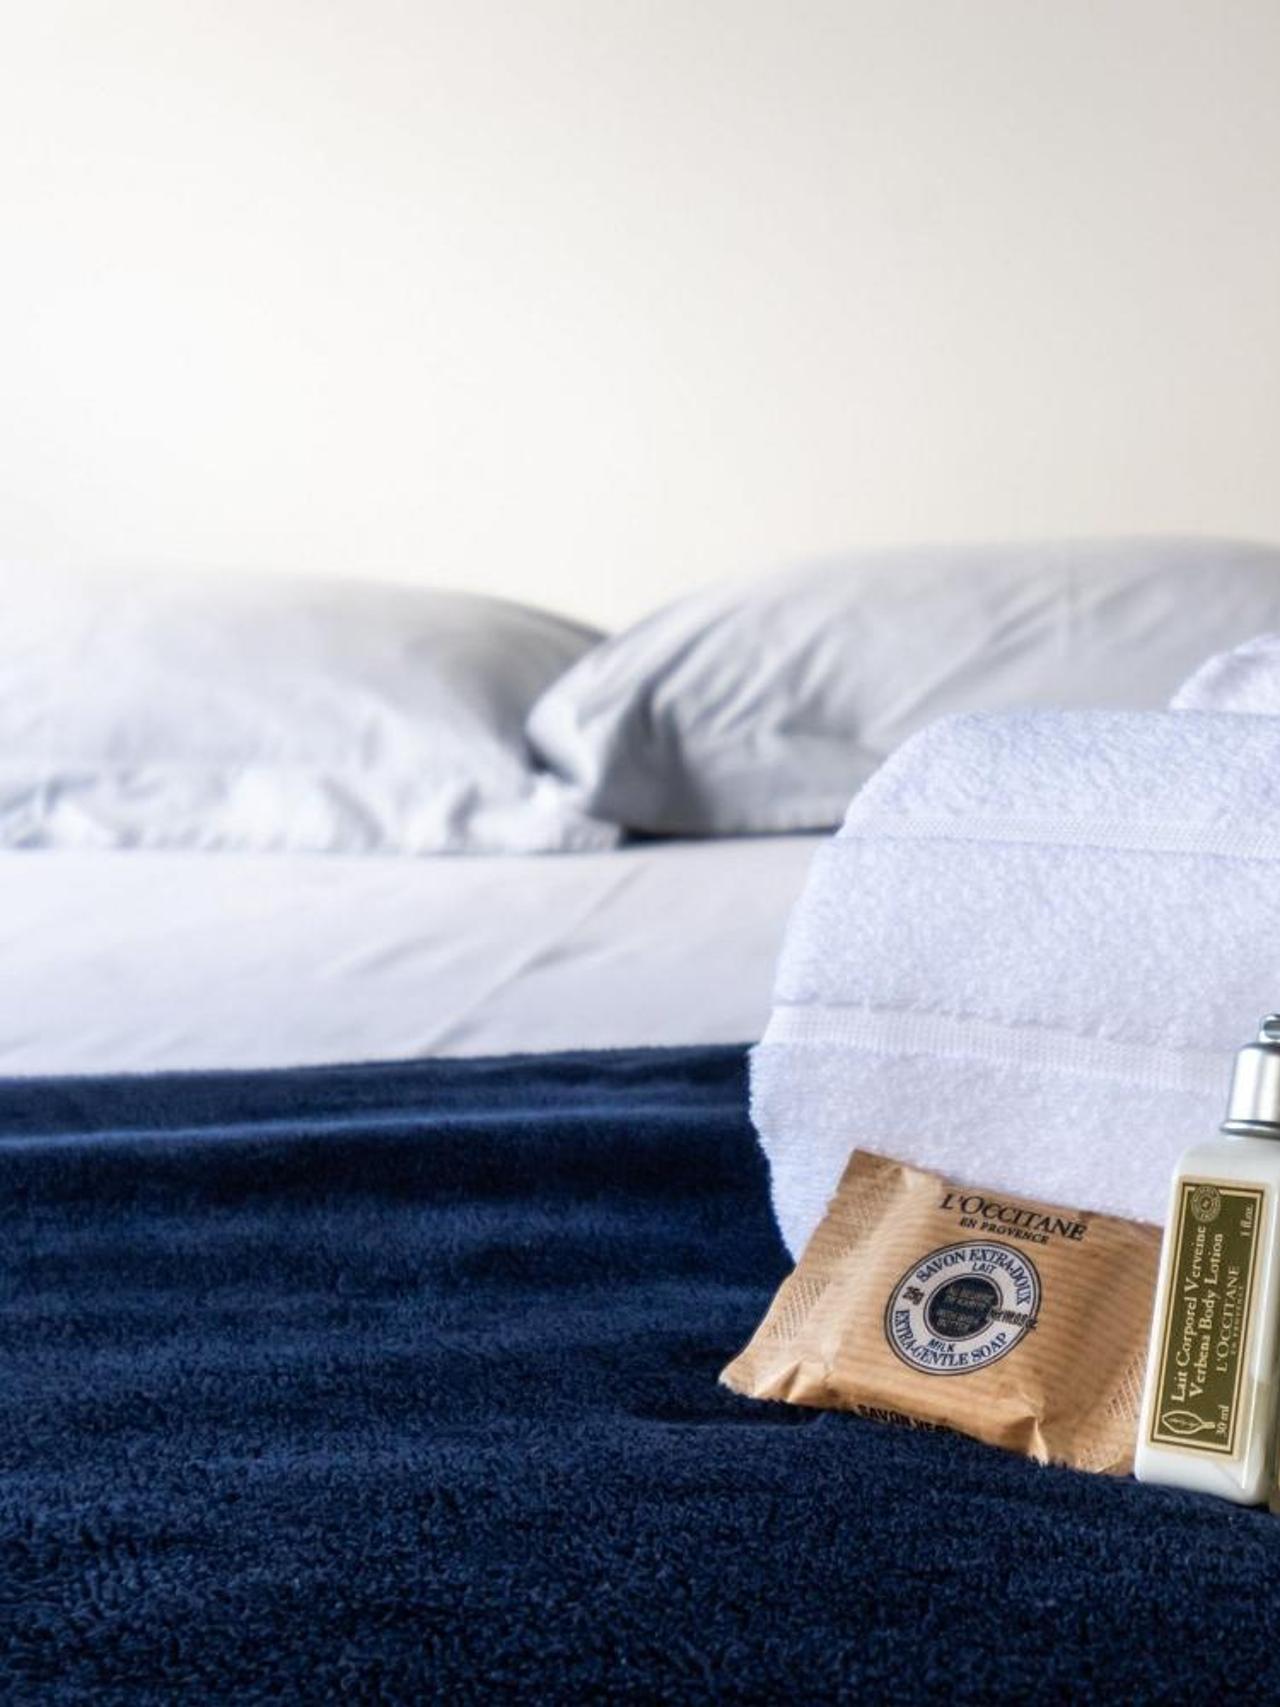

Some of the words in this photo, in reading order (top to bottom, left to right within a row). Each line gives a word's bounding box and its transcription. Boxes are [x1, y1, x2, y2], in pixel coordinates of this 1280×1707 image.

[940, 1193, 1087, 1241] L'OCCITANE
[960, 1217, 976, 1228] EN
[980, 1221, 1050, 1245] PROVENCE
[916, 1250, 966, 1282] SAVON
[969, 1249, 1031, 1305] EXTRA-DOUX
[972, 1262, 997, 1274] LAIT
[1184, 1226, 1206, 1292] Verveine
[1204, 1233, 1224, 1284] Lotion
[1175, 1295, 1198, 1367] Corporel
[1199, 1289, 1221, 1329] Body
[895, 1310, 969, 1366] EXTRA-GENTLE
[970, 1332, 1008, 1362] SOAP
[928, 1339, 955, 1352] MILK
[1171, 1370, 1188, 1402] Lait
[1189, 1334, 1211, 1397] Verbena
